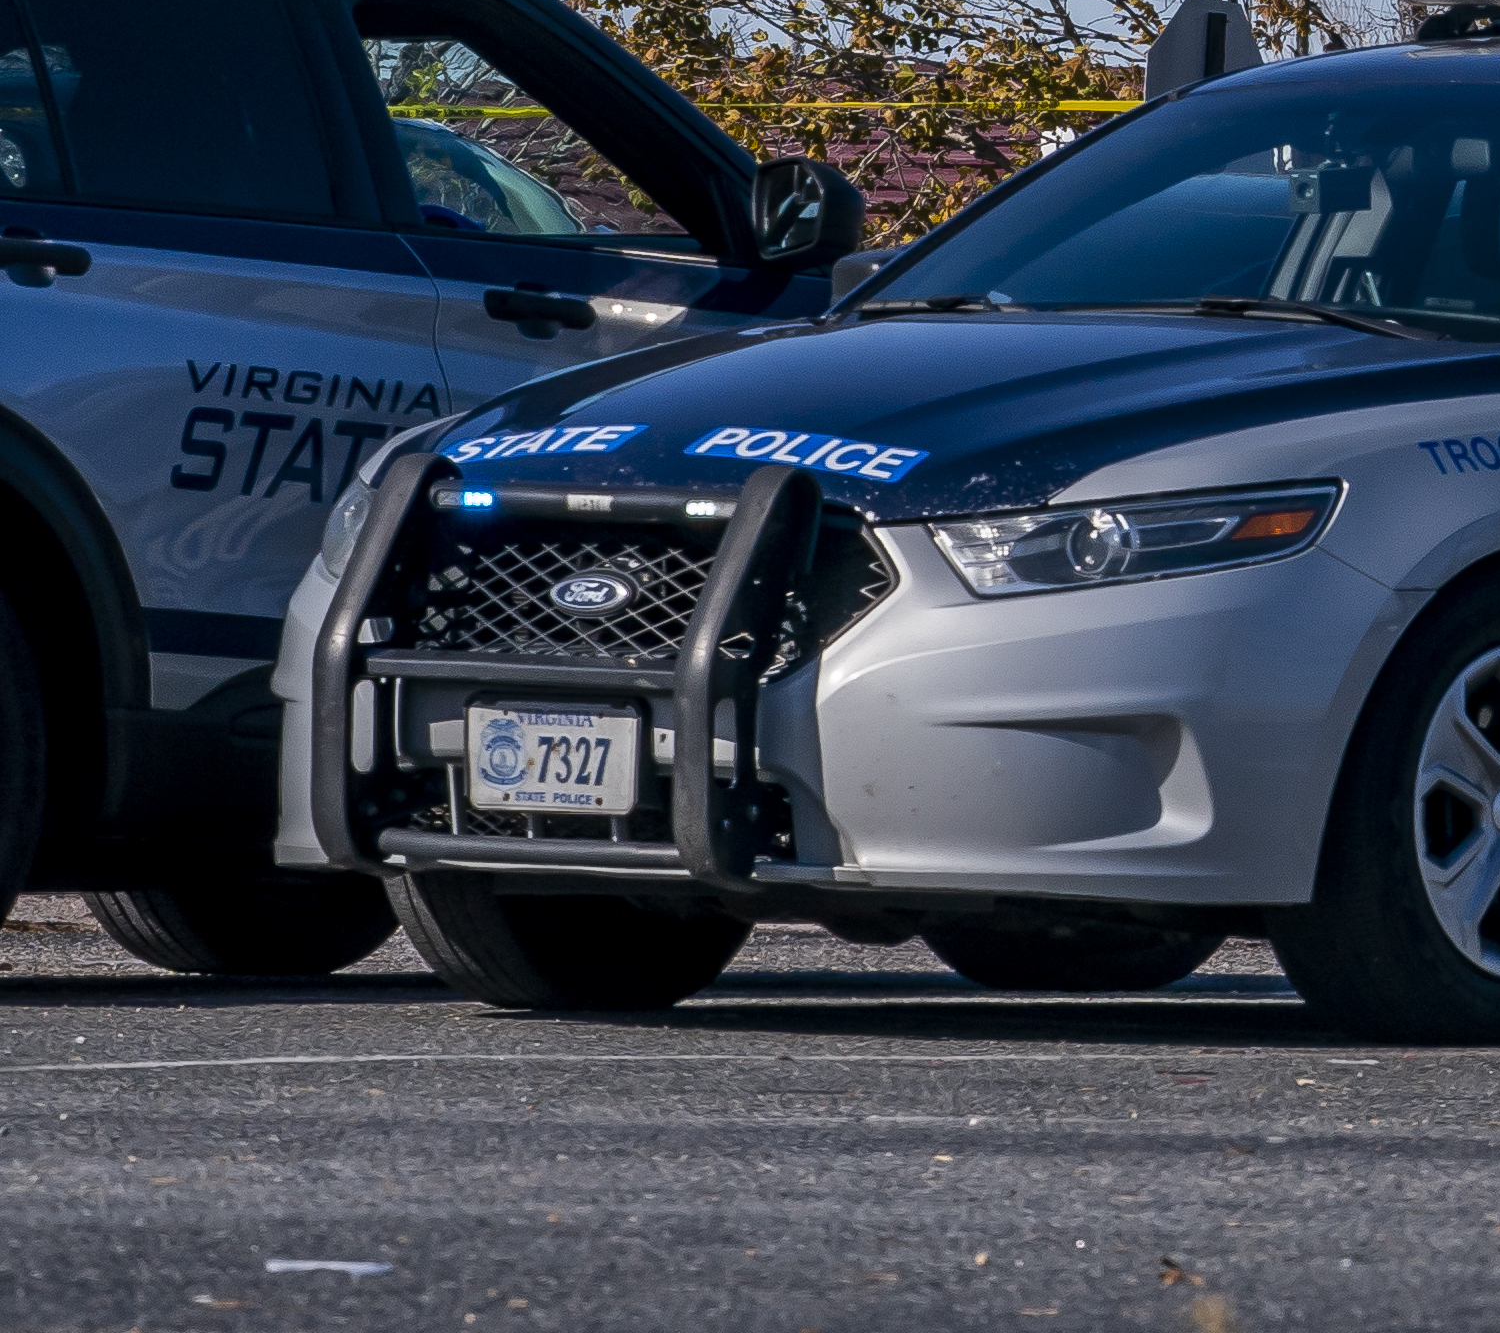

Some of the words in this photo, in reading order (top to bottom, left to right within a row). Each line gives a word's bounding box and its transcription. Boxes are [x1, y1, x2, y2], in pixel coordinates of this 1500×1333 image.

[186, 358, 441, 417] VIRGINIA
[170, 405, 412, 504] STAT
[446, 425, 636, 464] STATE
[693, 427, 919, 481] POLICE
[564, 582, 610, 602] Ford
[517, 713, 595, 728] VIRGINIA
[537, 735, 613, 787] 7327
[515, 791, 547, 803] STATE
[553, 792, 594, 805] POLICE
